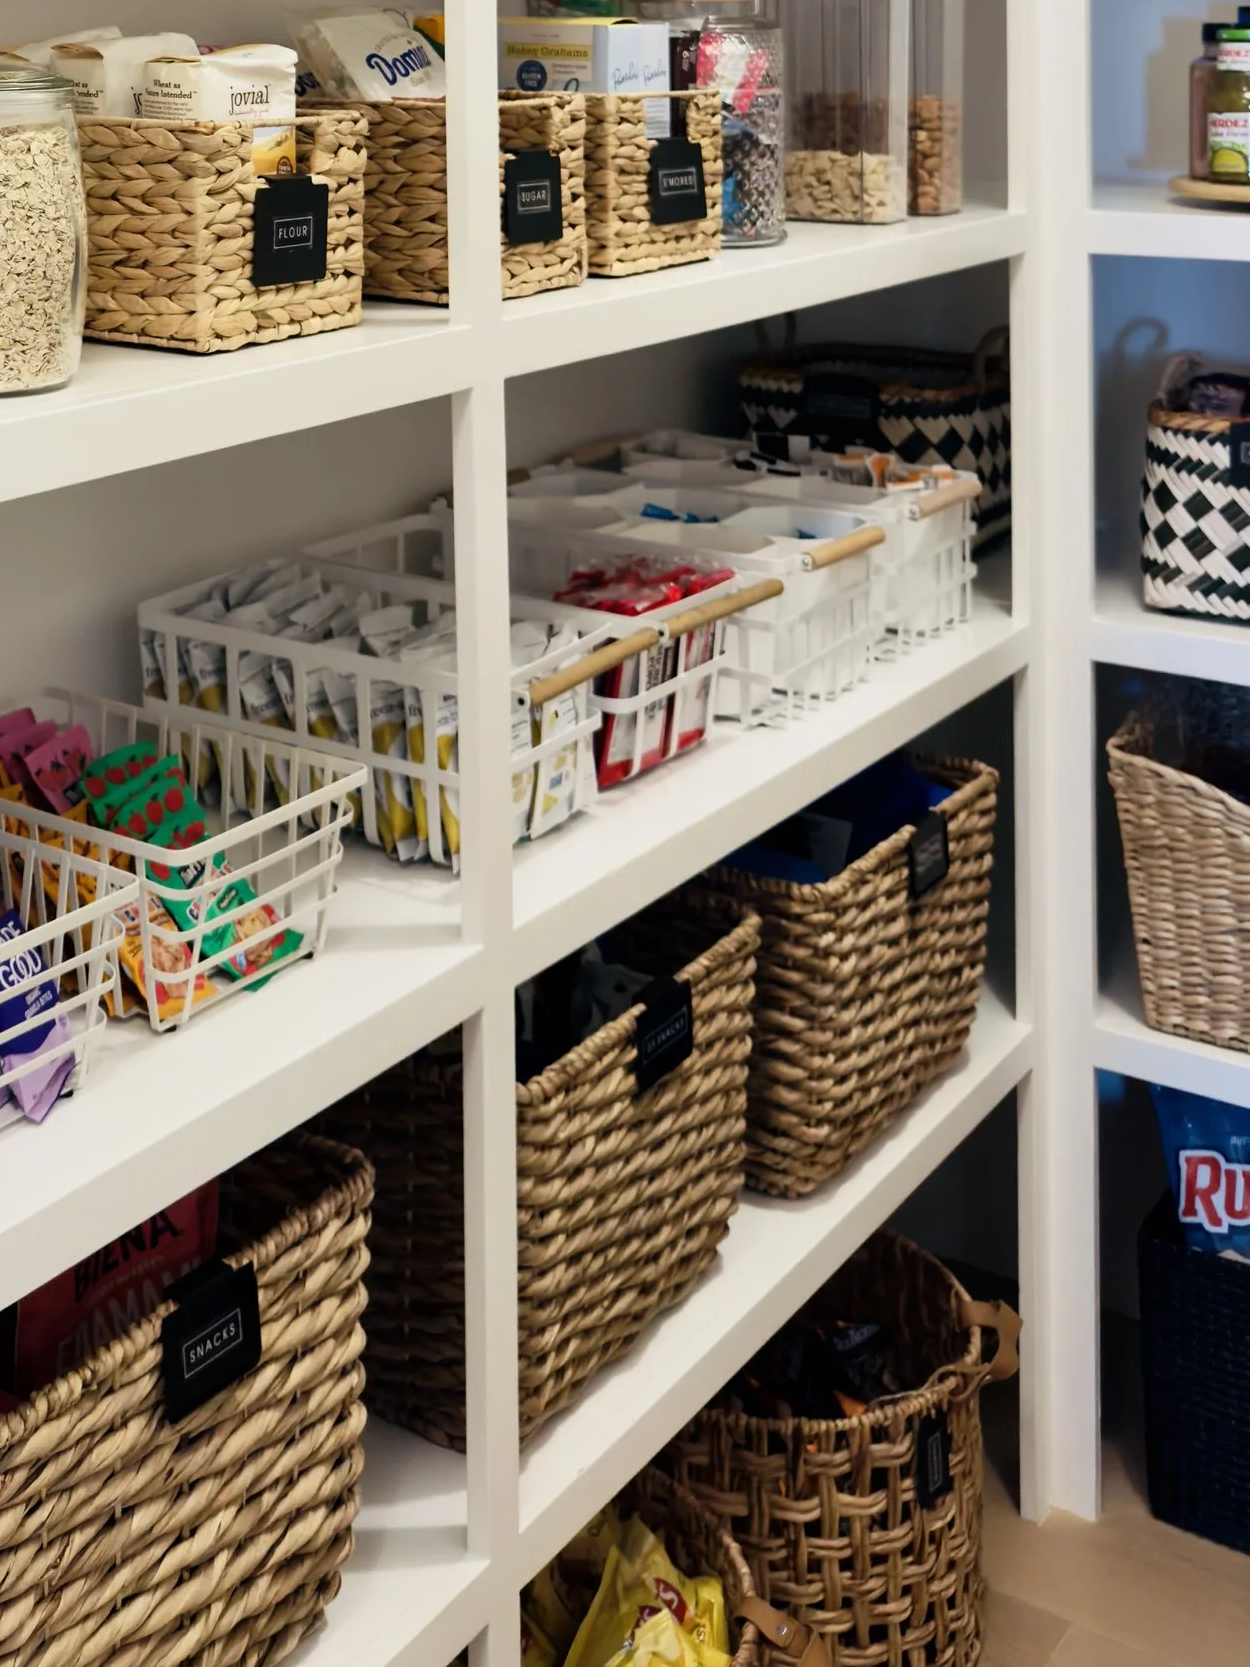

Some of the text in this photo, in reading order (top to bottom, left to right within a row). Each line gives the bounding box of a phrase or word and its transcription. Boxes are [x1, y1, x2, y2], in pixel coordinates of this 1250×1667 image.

[540, 45, 589, 58] Grahams
[153, 79, 181, 89] Wheat as
[228, 84, 270, 116] jovial
[662, 174, 693, 188] S'MORES
[521, 190, 547, 202] SUGAR
[278, 226, 308, 240] FLOUR
[189, 1321, 236, 1364] SNACKS
